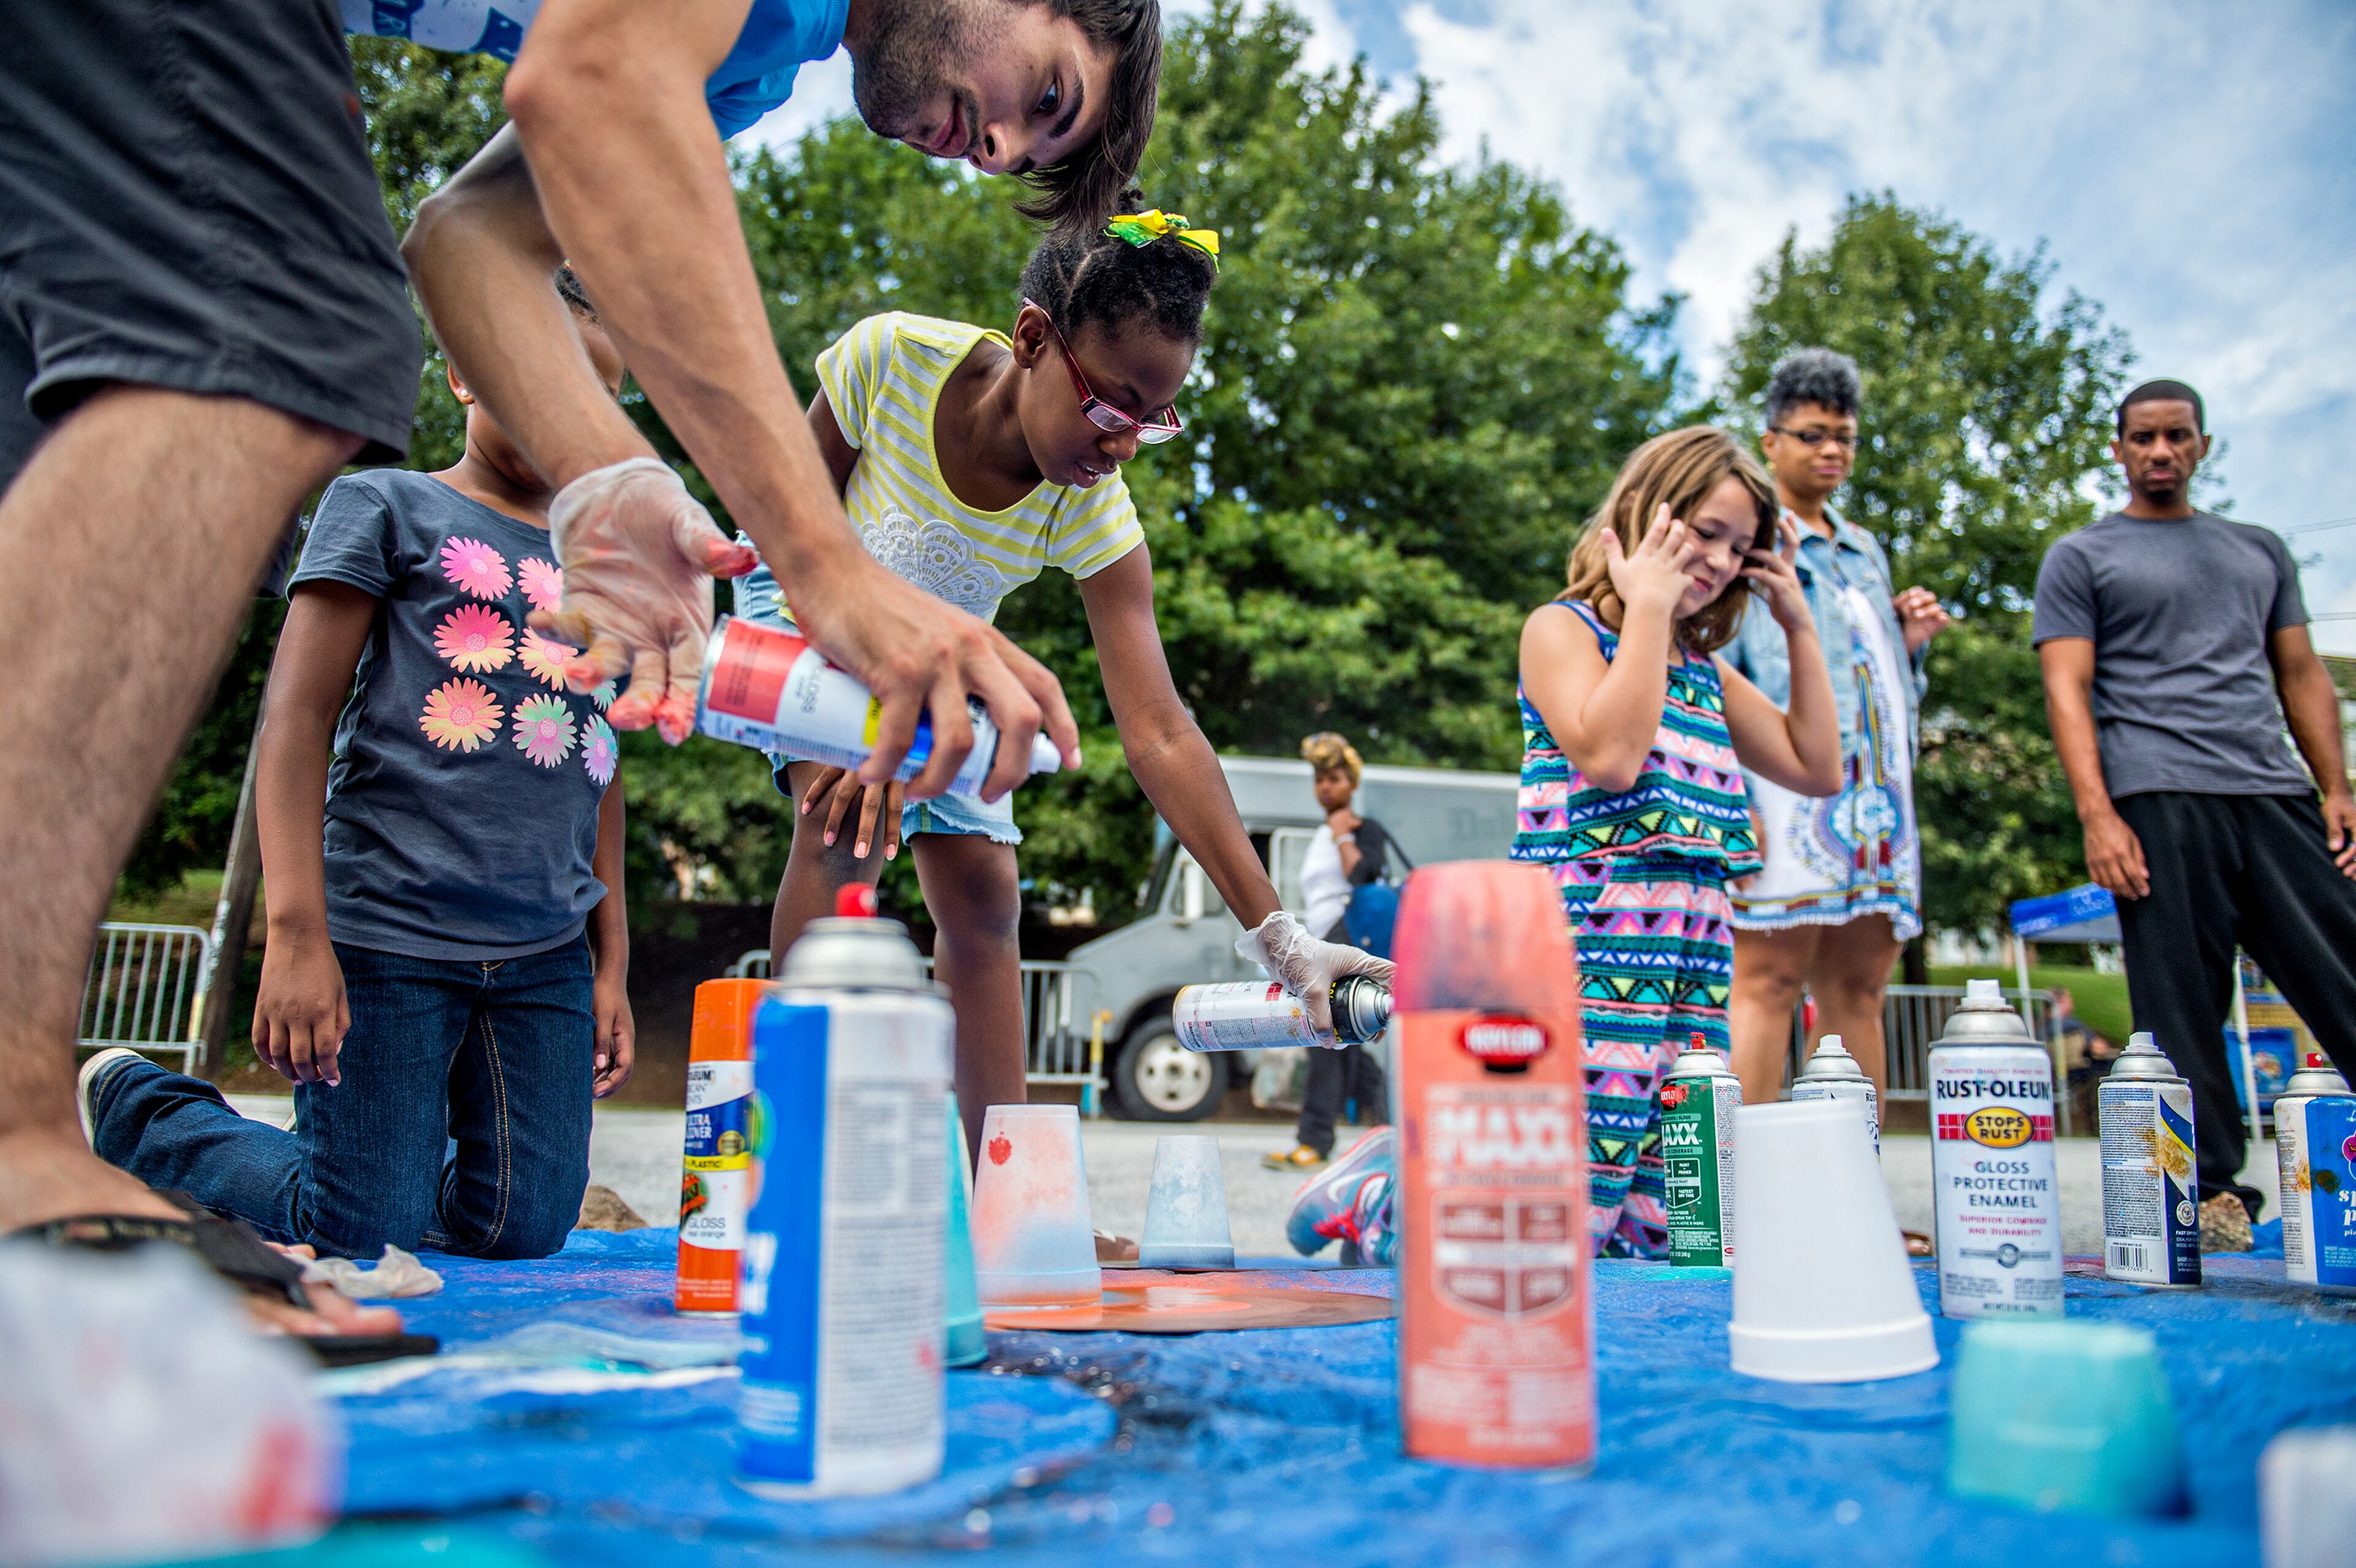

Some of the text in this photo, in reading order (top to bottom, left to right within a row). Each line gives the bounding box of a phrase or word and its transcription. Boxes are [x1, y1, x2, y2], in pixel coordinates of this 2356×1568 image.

[1976, 1116, 2023, 1126] STOPS
[1437, 1106, 1575, 1167] MAXX
[1980, 1129, 2022, 1139] RUST
[1974, 1161, 2030, 1174] GLOSS
[1954, 1177, 2049, 1191] PROTECTIVE
[1969, 1194, 2038, 1208] ENAMEL
[688, 1217, 726, 1229] GLOSS
[1958, 1215, 2003, 1224] SUPERIOR
[1990, 1228, 2042, 1237] DURABILITY
